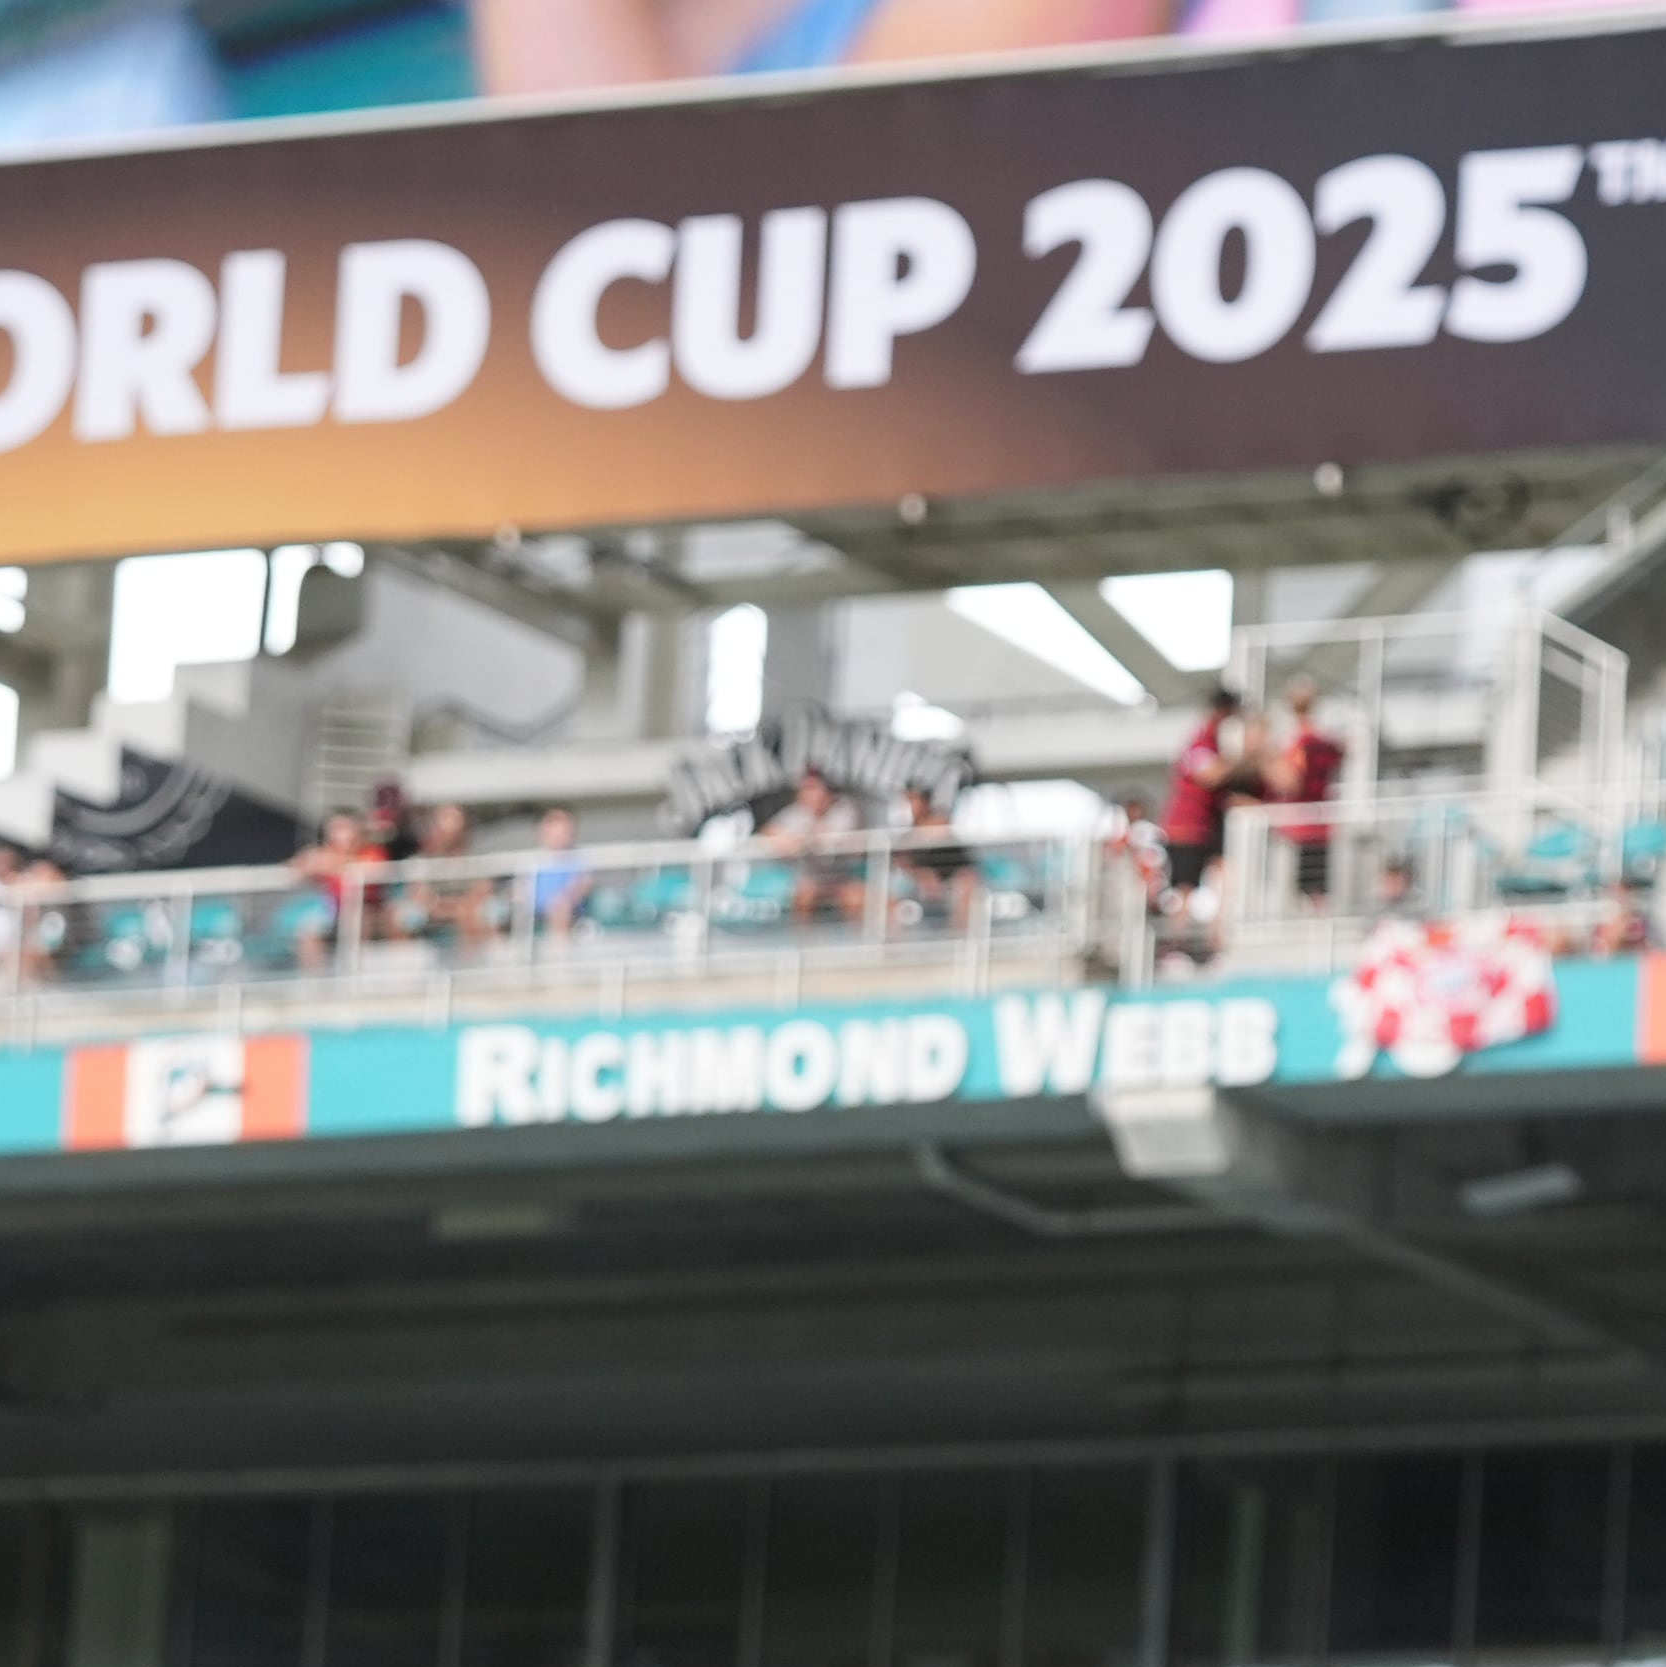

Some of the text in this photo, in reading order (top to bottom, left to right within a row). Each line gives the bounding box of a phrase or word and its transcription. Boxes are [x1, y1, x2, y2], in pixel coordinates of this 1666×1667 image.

[528, 197, 977, 412] CUP
[455, 1012, 968, 1129] RICHMOND
[993, 990, 1278, 1097] WEBB
